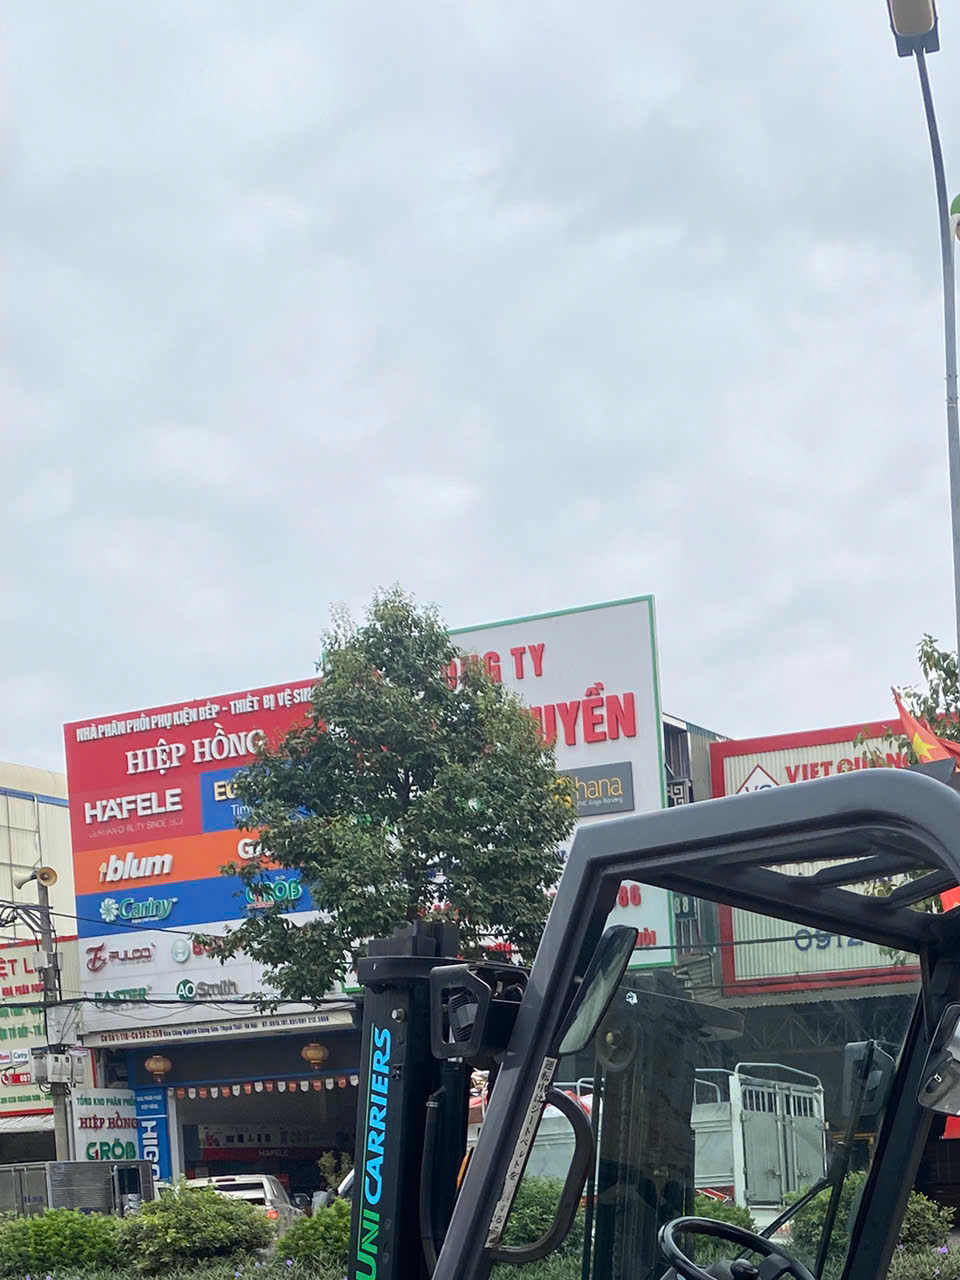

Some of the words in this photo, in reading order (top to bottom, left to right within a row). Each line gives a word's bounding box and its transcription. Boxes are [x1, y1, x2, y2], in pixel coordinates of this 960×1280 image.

[510, 643, 545, 680] TY
[76, 723, 98, 742] NHÀ
[98, 720, 126, 738] PHÂN
[151, 713, 173, 729] PHỤ
[173, 706, 198, 725] KIỆN
[198, 700, 220, 720] BẾP
[229, 693, 260, 714] THIẾT
[263, 694, 275, 710] BỊ
[277, 688, 293, 708] VỆ
[293, 686, 314, 704] SIN
[531, 681, 637, 746] UYỀN
[125, 738, 186, 775] HIỆP
[84, 788, 183, 824] HÄFELE
[105, 851, 174, 883] blum
[197, 978, 239, 998] Smith
[79, 1113, 105, 1132] HIỆP
[107, 1110, 139, 1129] HỒNG
